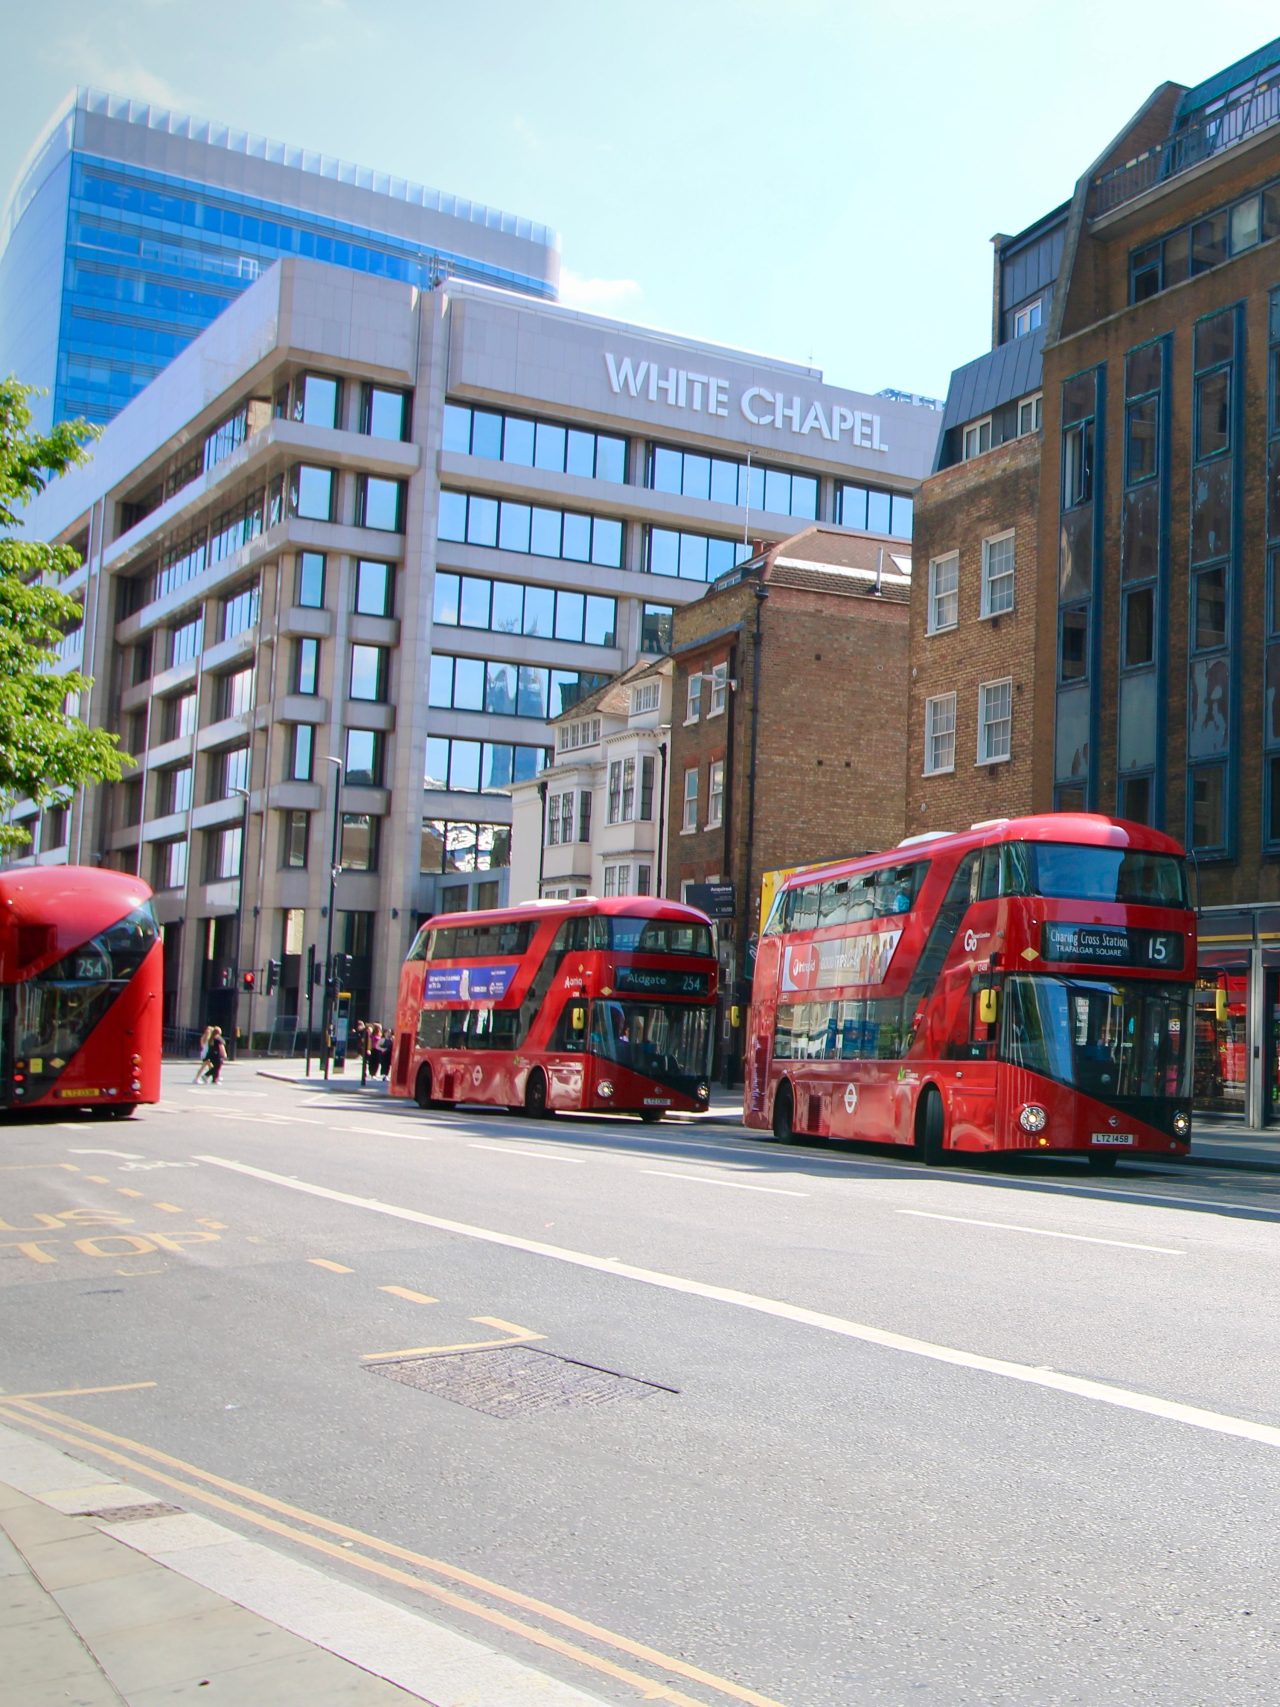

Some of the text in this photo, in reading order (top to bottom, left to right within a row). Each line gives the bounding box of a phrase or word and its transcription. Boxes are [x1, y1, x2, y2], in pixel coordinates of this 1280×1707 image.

[605, 353, 888, 451] WHITE CHAPEL
[1050, 929, 1128, 948] Charing Cross Station
[1056, 944, 1122, 956] TRAFALGAR SQUARE
[1148, 937, 1167, 960] 15
[78, 959, 103, 977] 254
[627, 973, 667, 986] Aldgate
[682, 975, 700, 991] 254
[0, 1209, 135, 1231] US
[0, 1231, 222, 1264] TOP
